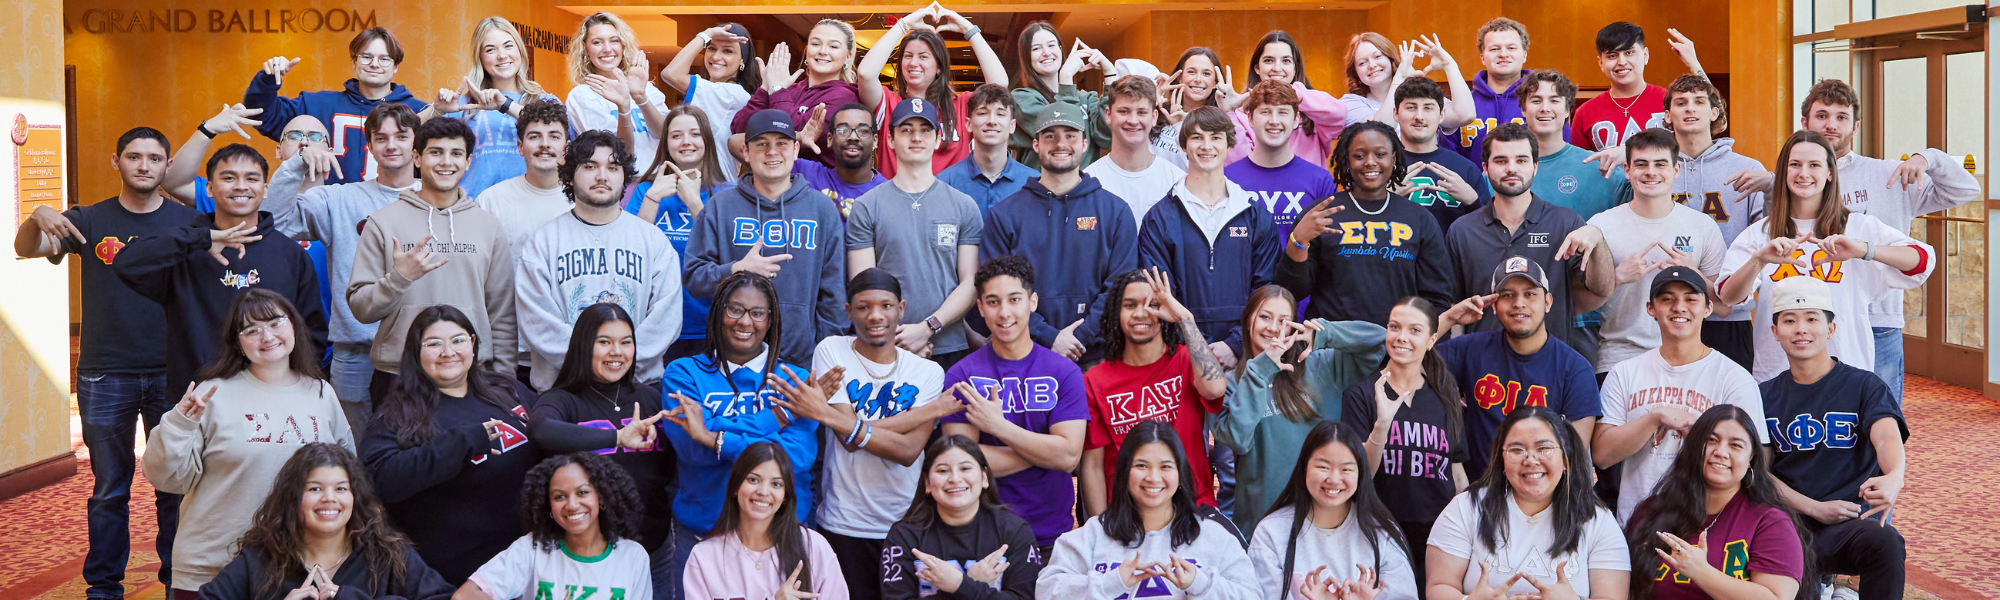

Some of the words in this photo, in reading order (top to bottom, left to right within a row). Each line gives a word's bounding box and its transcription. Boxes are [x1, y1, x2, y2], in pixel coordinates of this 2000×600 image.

[82, 9, 197, 33] GRAND
[208, 8, 377, 33] BALLROOM
[437, 243, 450, 254] CHI
[454, 243, 478, 254] ALPHA
[1529, 235, 1548, 244] IFC
[1338, 246, 1377, 257] Lambda
[558, 247, 608, 285] SIGMA
[615, 248, 643, 285] CHI
[1627, 389, 1647, 412] TAU
[1647, 386, 1683, 405] KAPPA
[1685, 389, 1716, 414] OMEG
[1389, 420, 1449, 454] AMMA
[1383, 449, 1403, 475] HI
[882, 546, 904, 566] SP
[883, 563, 903, 583] 22
